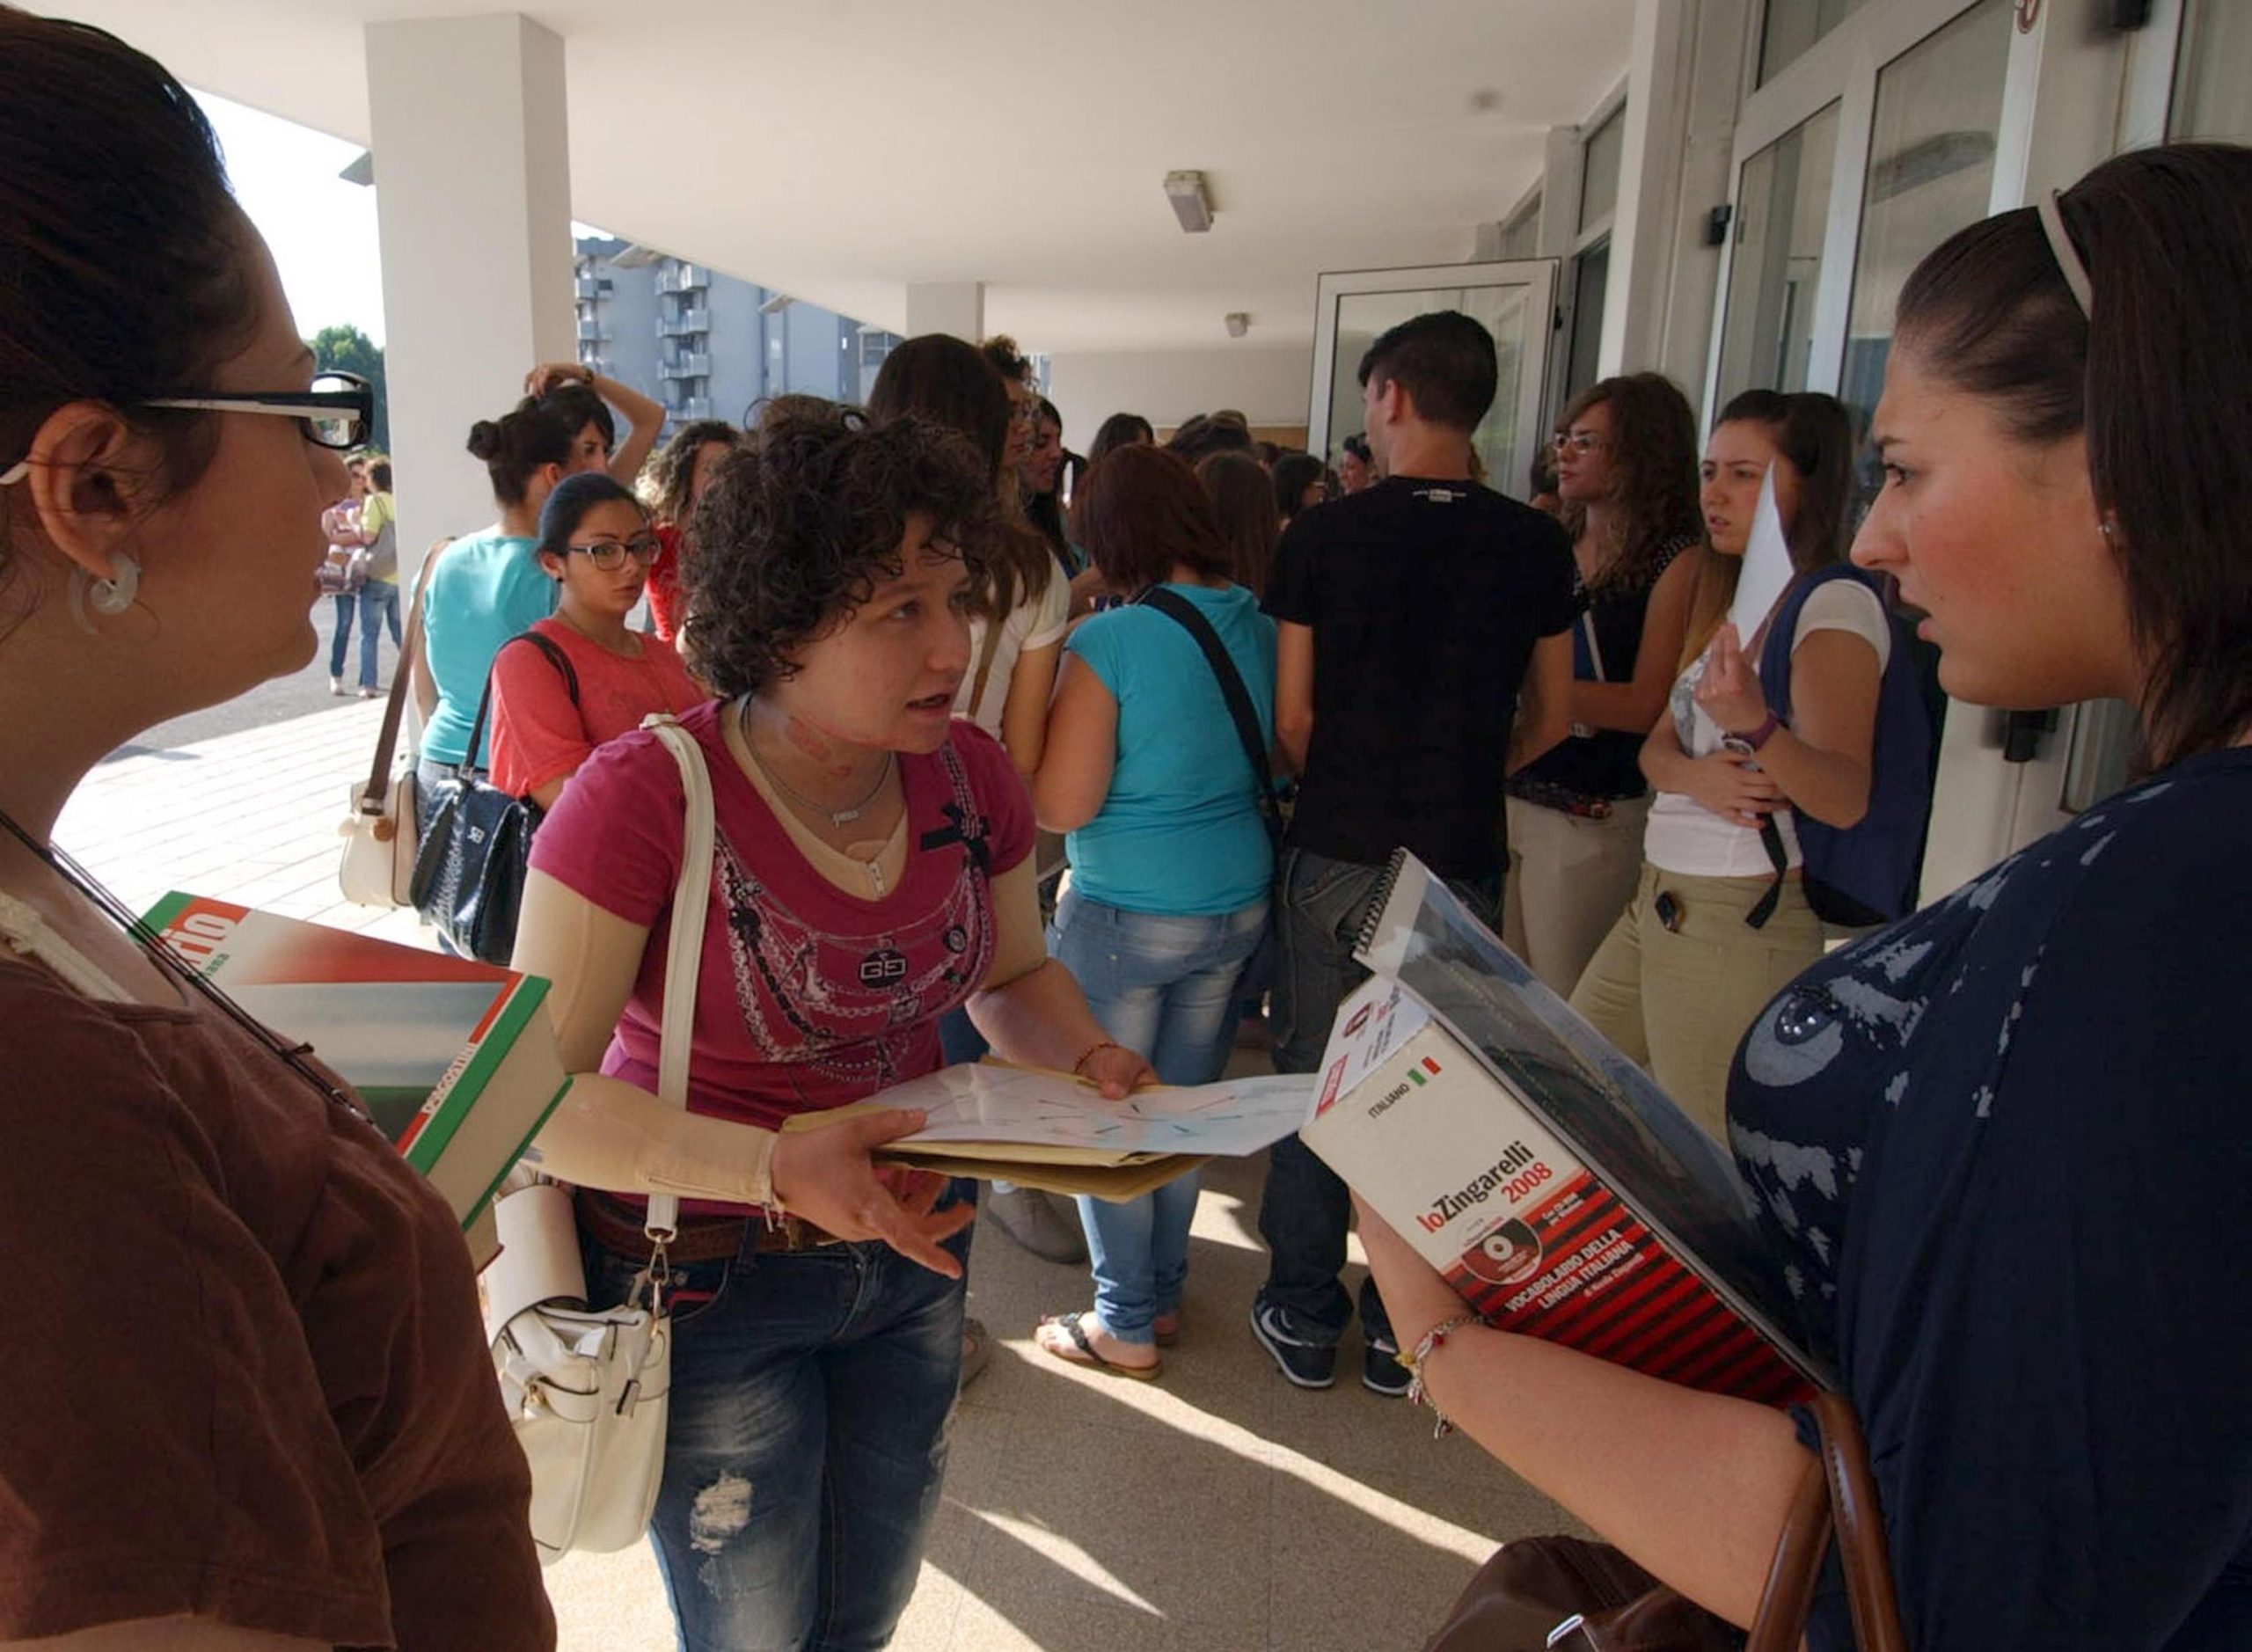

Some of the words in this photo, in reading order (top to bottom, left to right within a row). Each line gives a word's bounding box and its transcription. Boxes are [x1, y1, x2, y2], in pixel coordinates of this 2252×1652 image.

[1368, 1083, 1410, 1119] ITALIANO
[1501, 1161, 1553, 1204] 2008
[1504, 1254, 1583, 1312] VOCABOLARIO
[1581, 1229, 1622, 1260] DELLA
[1539, 1276, 1583, 1310] LINGUA
[1579, 1240, 1634, 1281] ITALIANA
